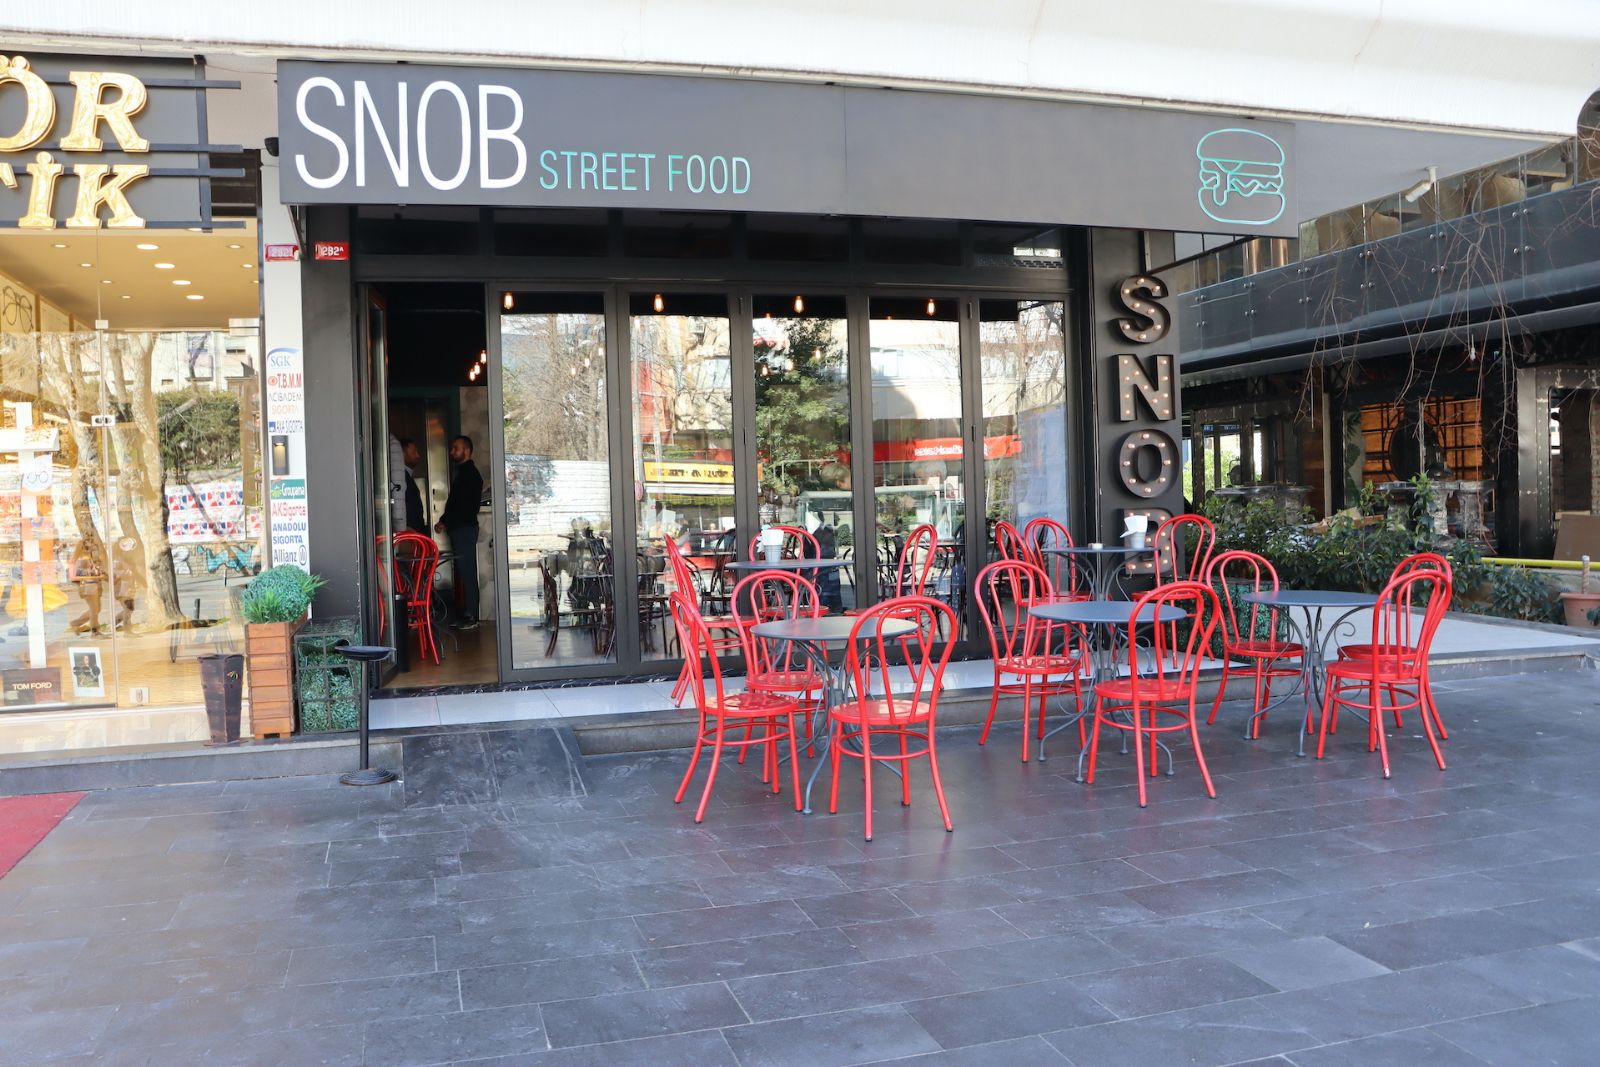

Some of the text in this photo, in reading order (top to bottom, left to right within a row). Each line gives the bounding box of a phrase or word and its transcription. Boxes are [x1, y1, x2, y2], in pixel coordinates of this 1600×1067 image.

[295, 77, 751, 194] SNOB STREET FOOD
[0, 151, 149, 228] İK
[270, 356, 291, 367] SGK
[1117, 275, 1180, 576] SNOB
[273, 522, 307, 532] ANADOLU
[273, 548, 297, 563] Allianz
[12, 682, 53, 690] TOM FORD
